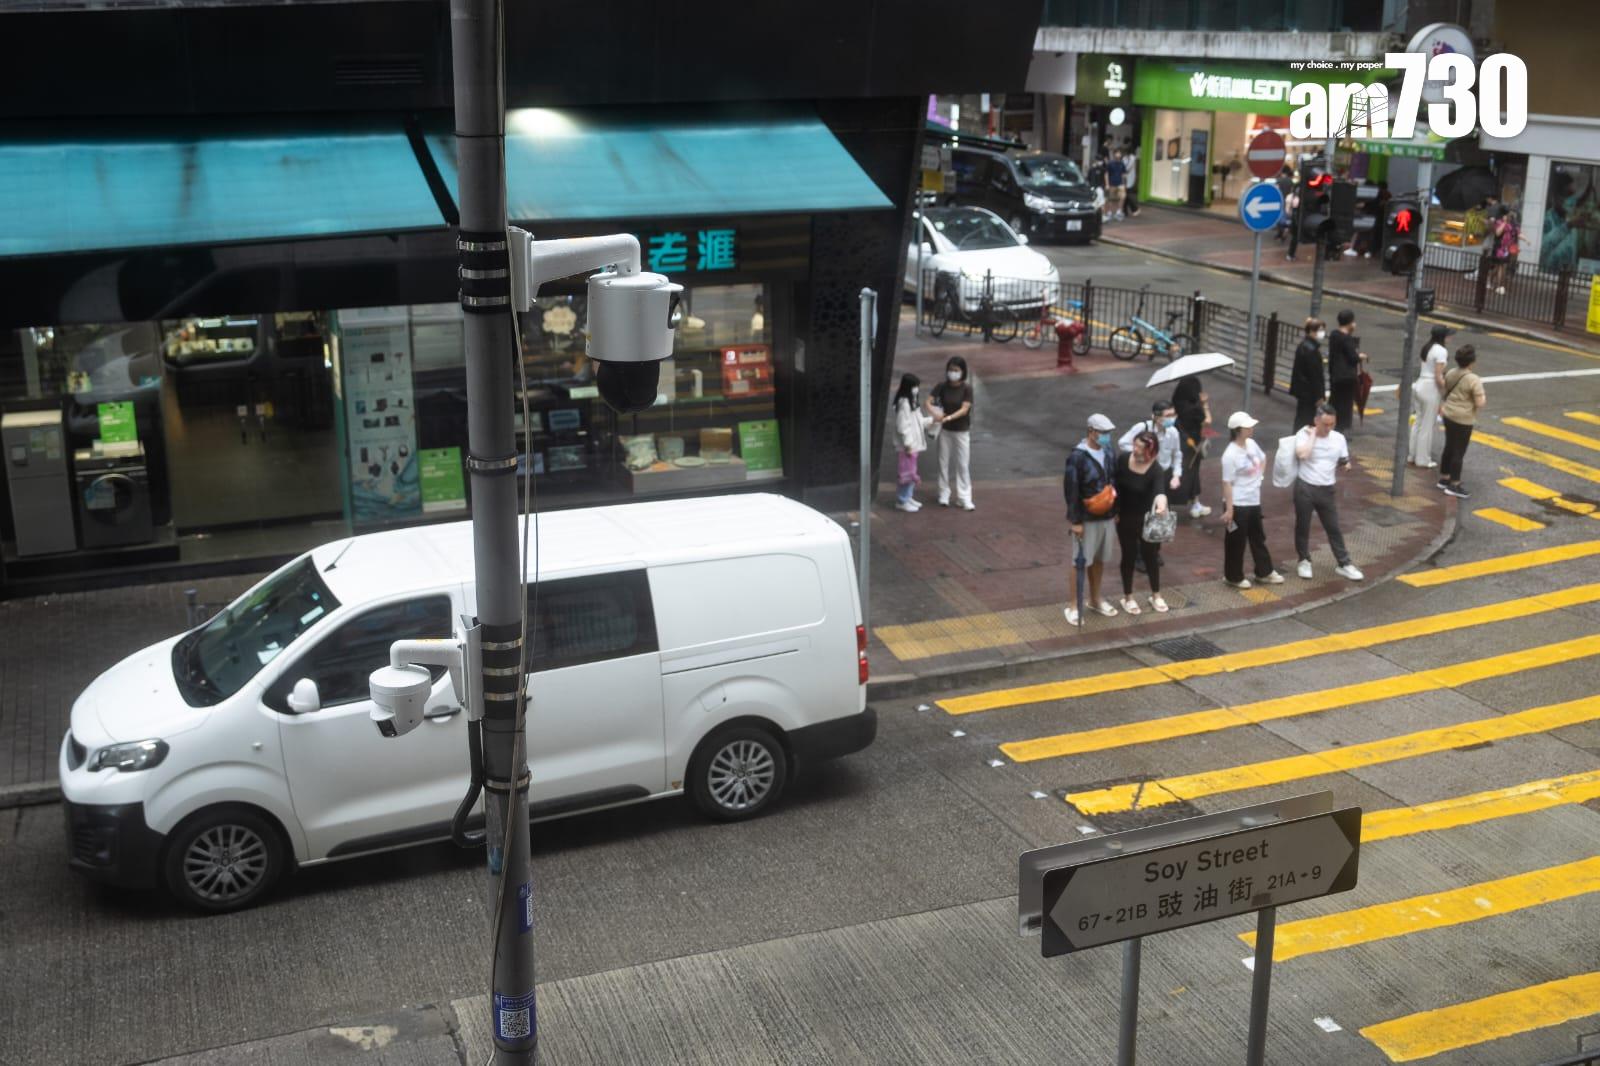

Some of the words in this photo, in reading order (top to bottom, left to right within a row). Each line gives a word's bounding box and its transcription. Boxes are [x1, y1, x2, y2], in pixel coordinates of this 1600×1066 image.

[1144, 860, 1188, 883] Soy
[1197, 839, 1269, 872] Street
[1157, 876, 1254, 919] 豉油街
